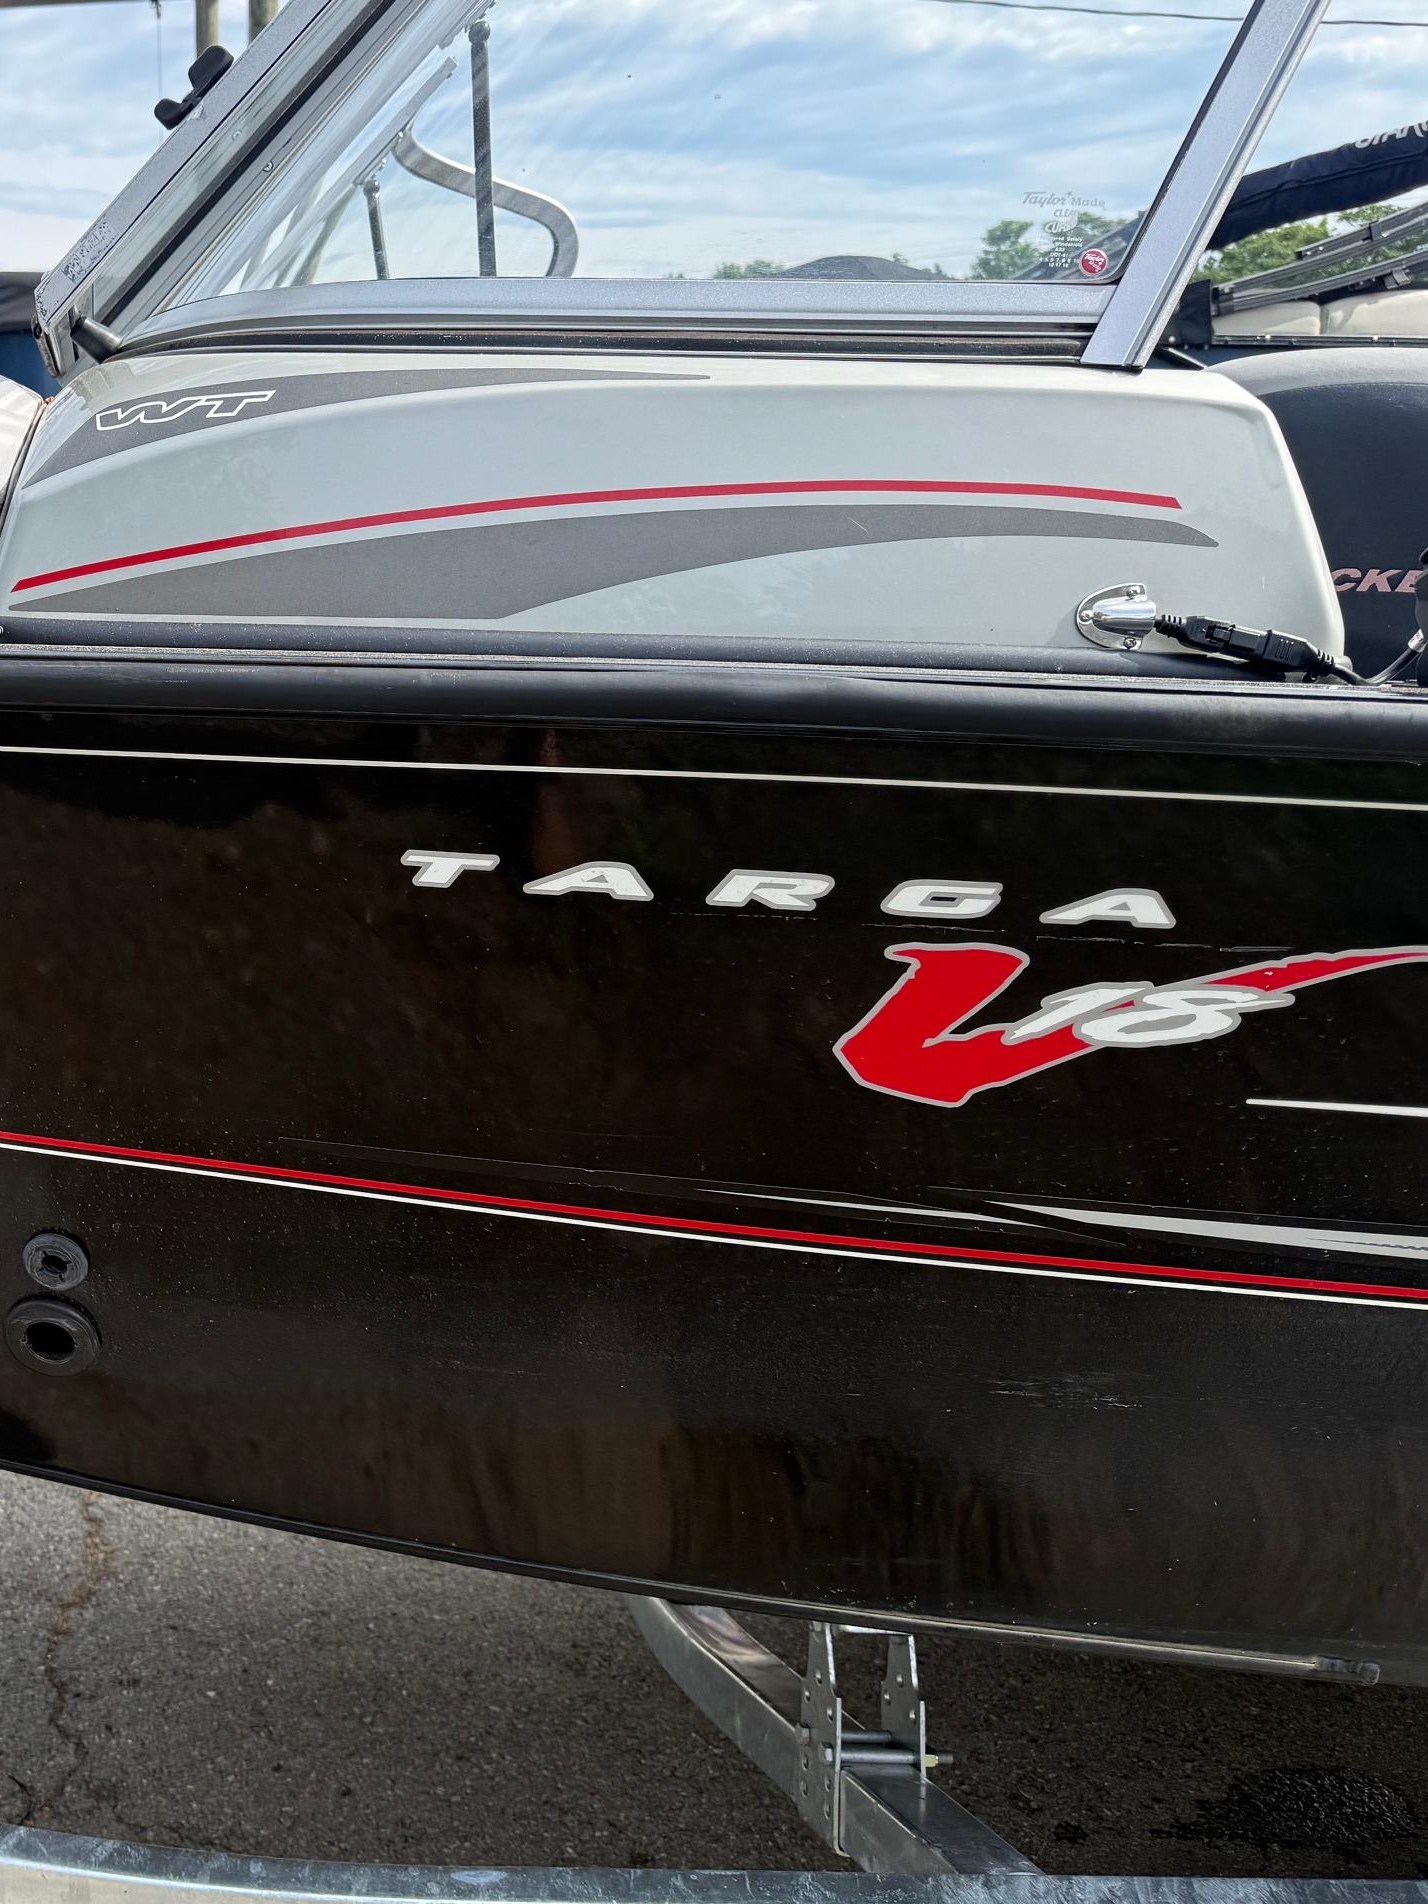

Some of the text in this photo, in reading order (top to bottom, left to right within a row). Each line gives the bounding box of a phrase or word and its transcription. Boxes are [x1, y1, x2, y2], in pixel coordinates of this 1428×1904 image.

[1022, 191, 1106, 208] Taylor Made
[95, 389, 277, 431] WT
[400, 848, 1177, 930] TARGA
